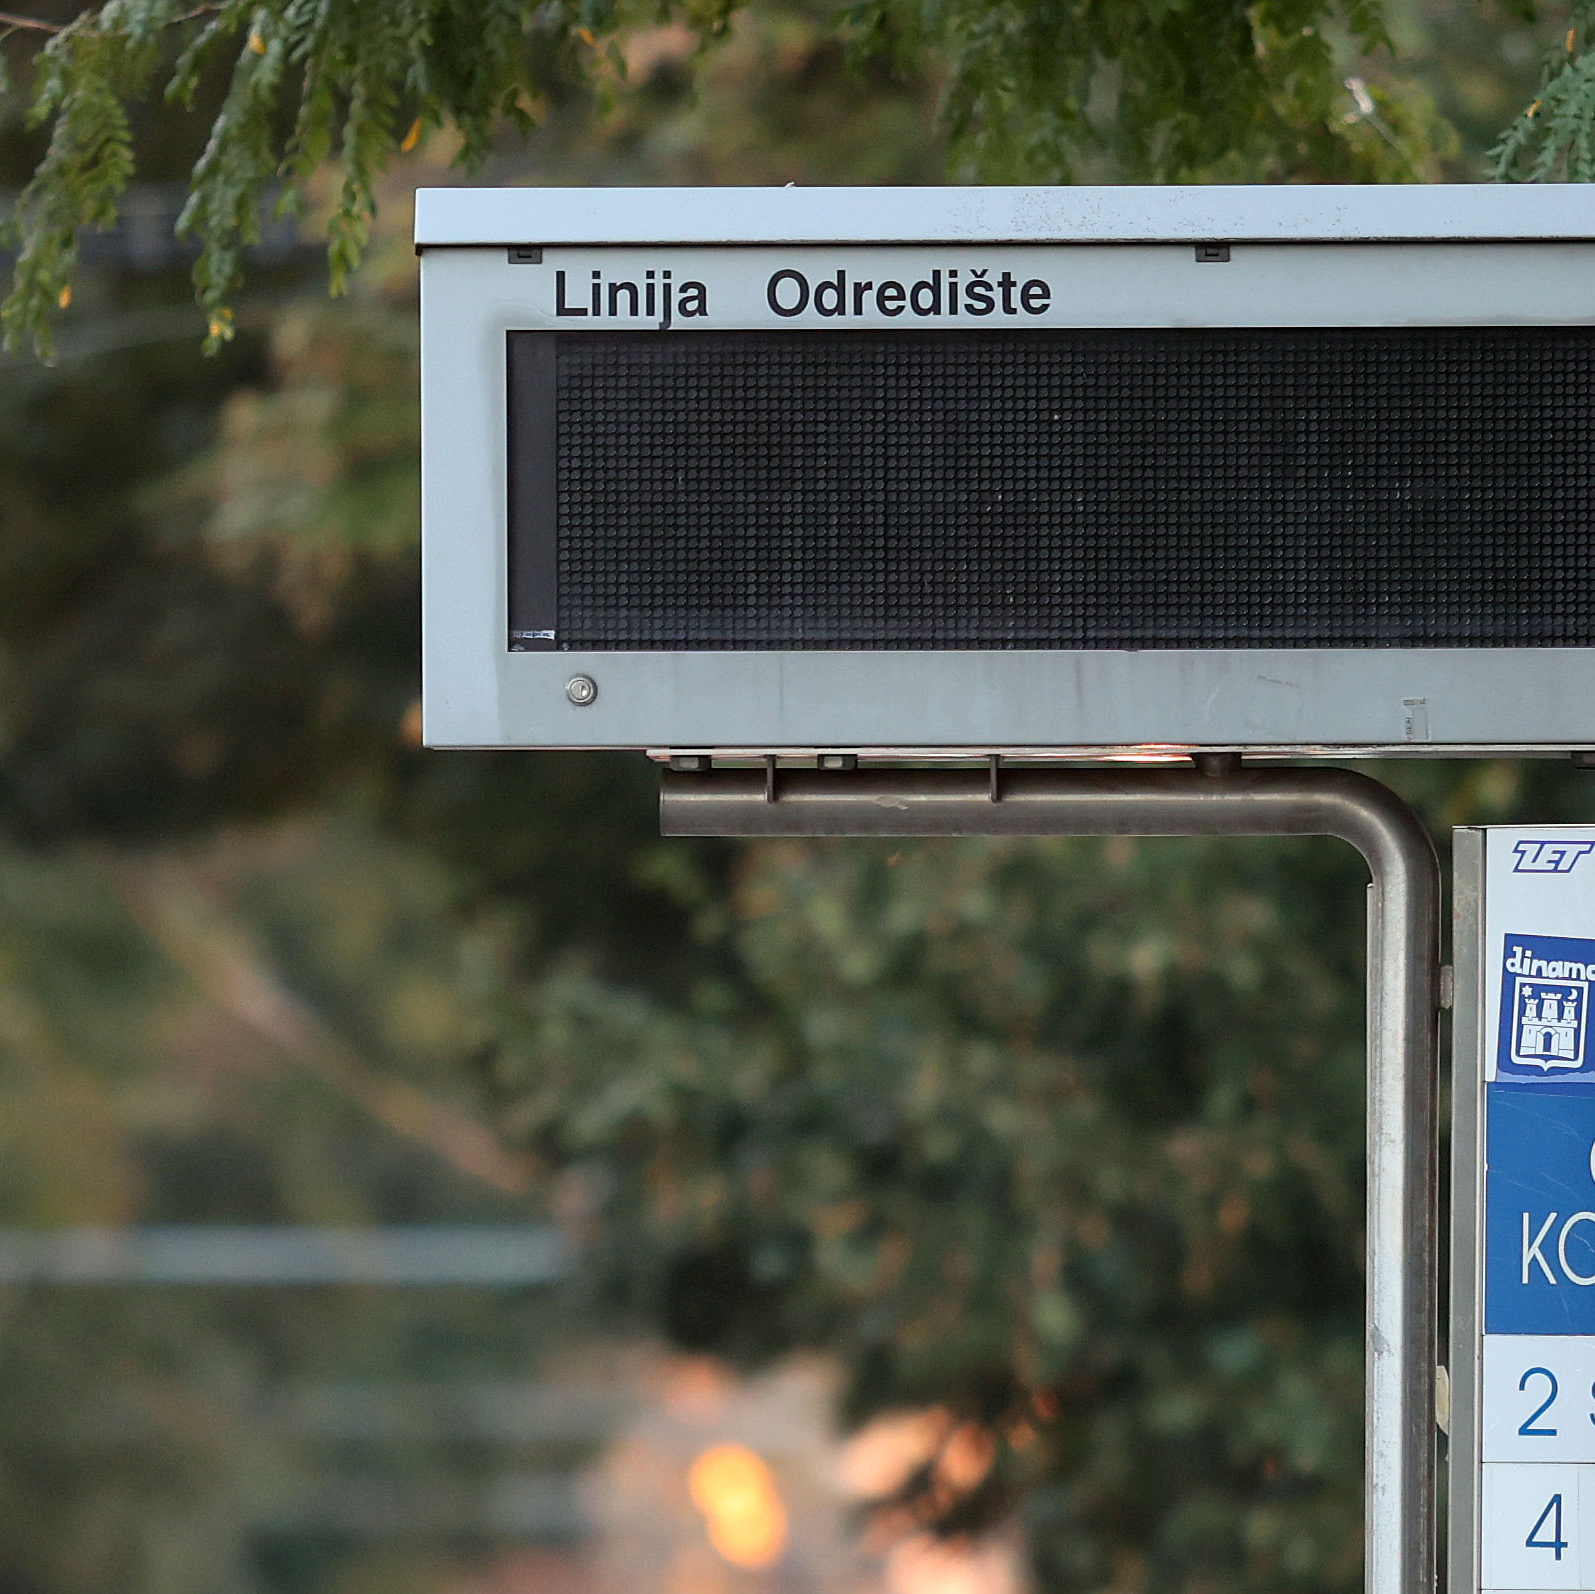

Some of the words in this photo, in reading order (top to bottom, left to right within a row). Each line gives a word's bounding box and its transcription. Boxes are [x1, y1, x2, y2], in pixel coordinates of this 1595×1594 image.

[554, 270, 710, 328] Linija
[767, 269, 1051, 317] Odredište
[1512, 840, 1595, 873] ZET
[1518, 1367, 1558, 1436] 2
[1525, 1494, 1568, 1560] 4
